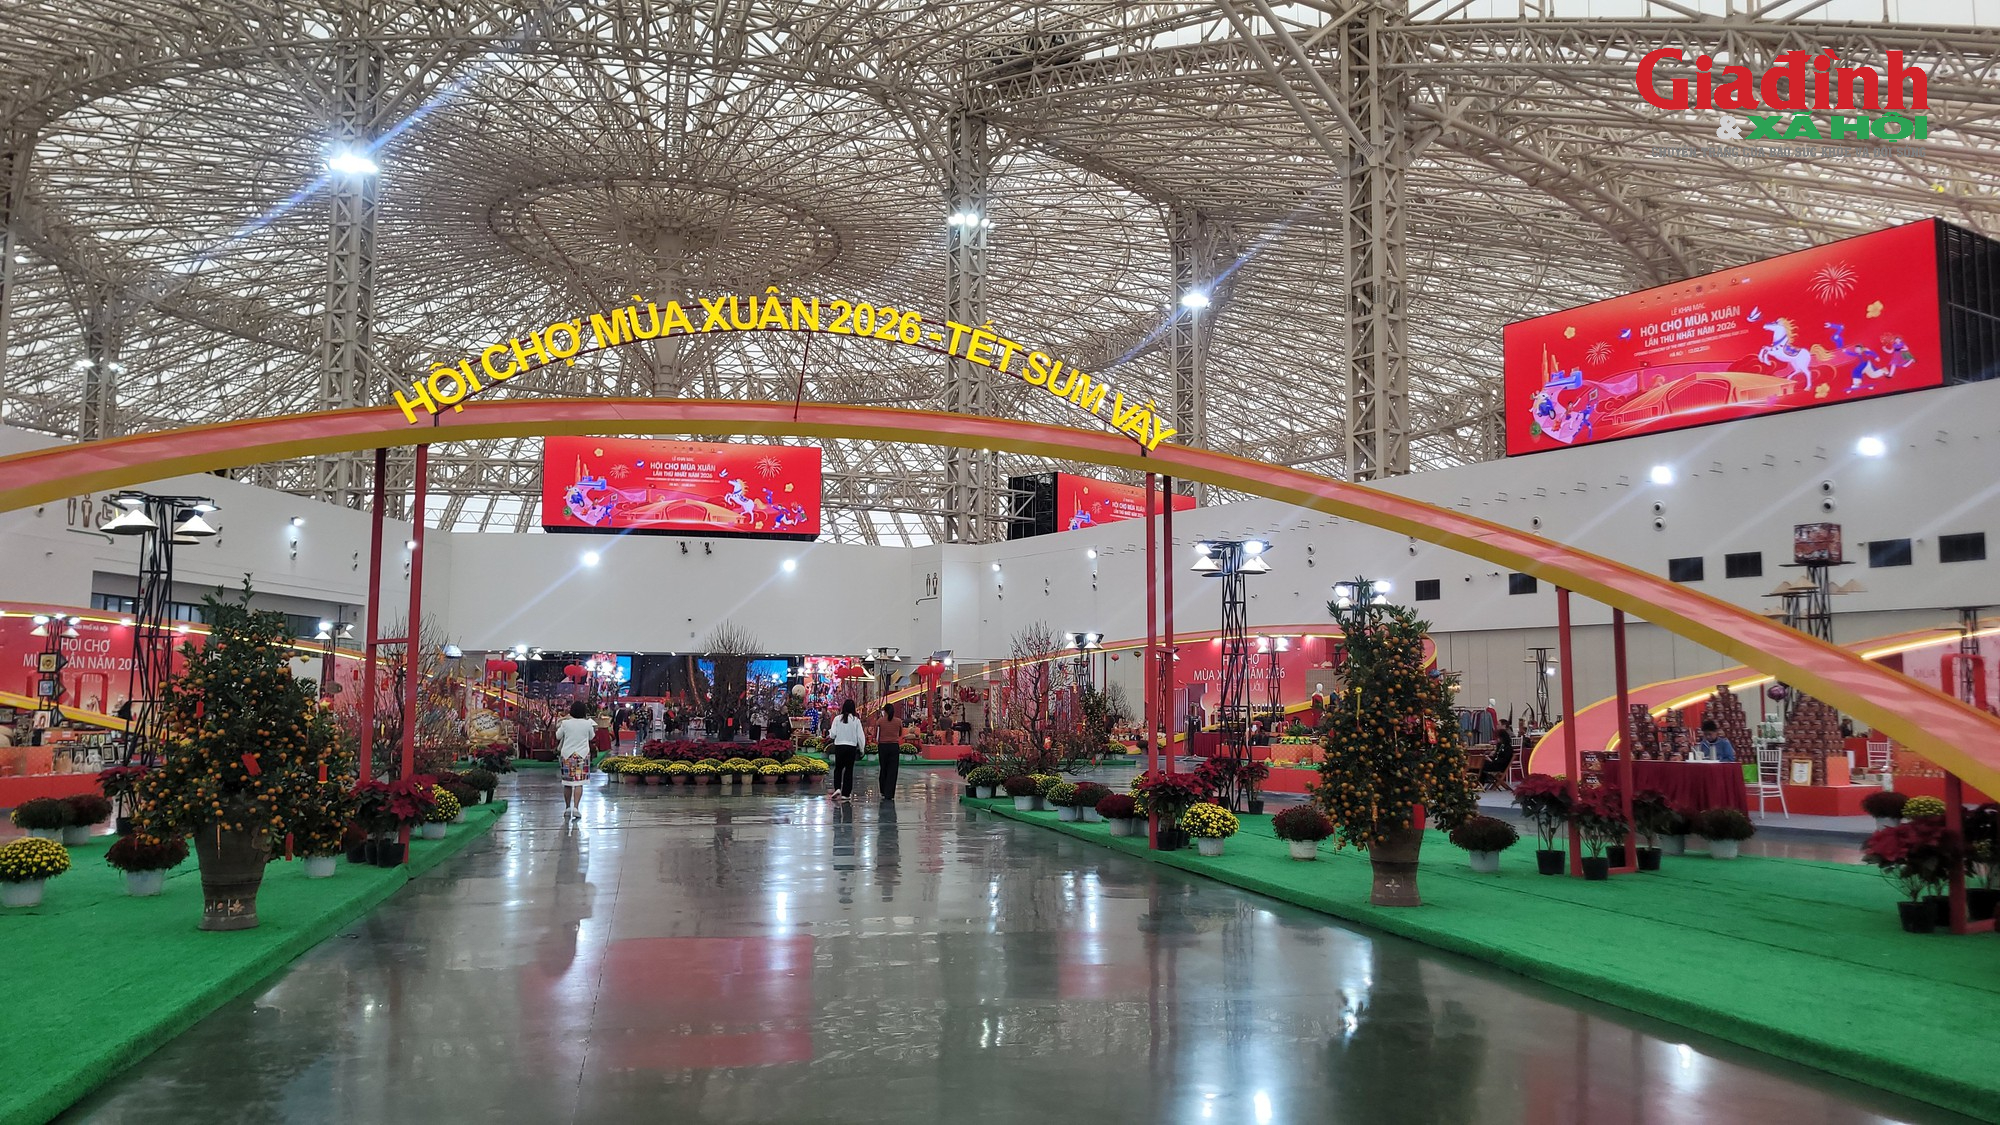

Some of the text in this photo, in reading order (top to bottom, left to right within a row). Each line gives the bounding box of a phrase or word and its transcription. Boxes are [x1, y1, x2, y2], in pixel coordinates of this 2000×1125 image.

[1640, 306, 1740, 338] HỘI CHỢ MÙA XUÂN
[1644, 320, 1736, 348] LẦN THỨ NHẤT NĂM 2026
[391, 359, 483, 425] HỘI
[480, 318, 582, 381] CHỢ
[590, 293, 694, 350] MÙA
[696, 285, 820, 333] XUÂN
[828, 298, 923, 346] 2026
[944, 319, 1024, 374] TẾT
[1021, 350, 1114, 416] SUM
[1110, 391, 1178, 452] VẦY
[650, 461, 716, 472] HỘI CHỢ MÙA XUÂN
[84, 638, 110, 656] CHỢ
[87, 655, 115, 670] NĂM
[1194, 668, 1215, 680] MÙA
